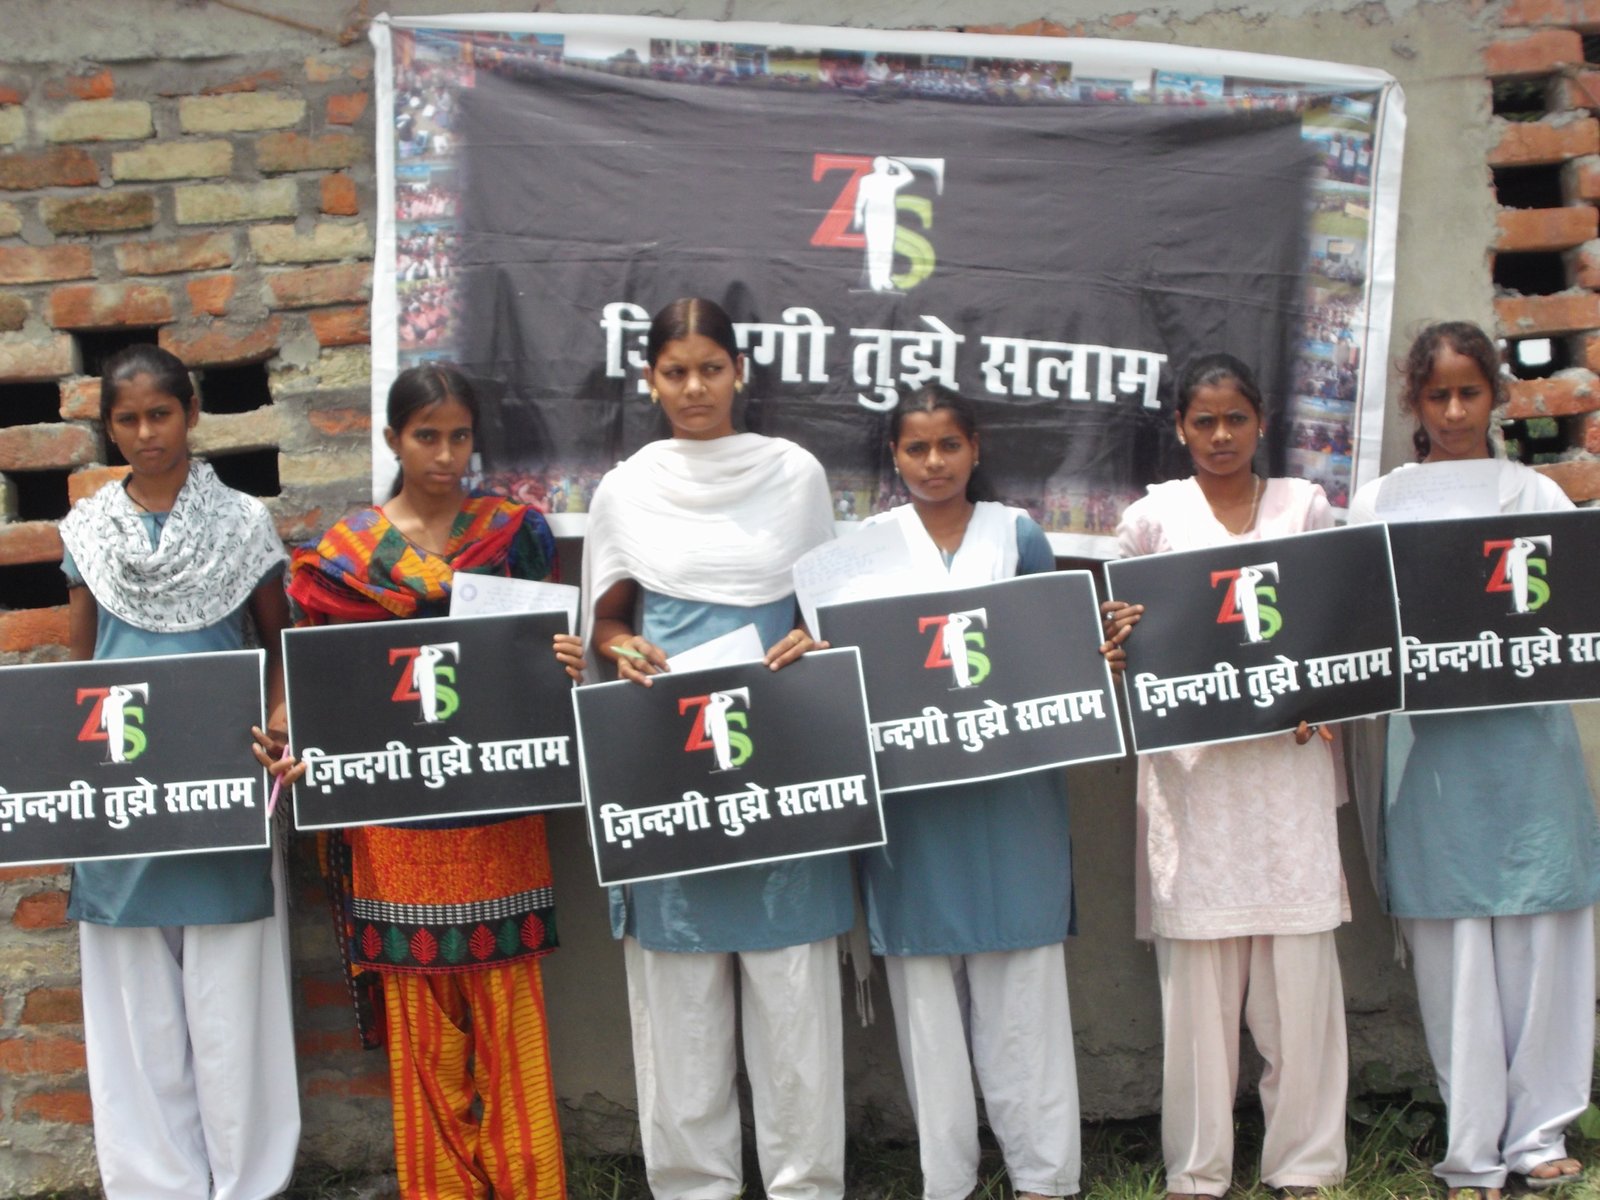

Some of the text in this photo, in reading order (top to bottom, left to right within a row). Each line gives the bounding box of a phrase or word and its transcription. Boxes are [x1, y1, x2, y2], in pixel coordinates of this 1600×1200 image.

[849, 314, 966, 411] तुझे
[980, 335, 1168, 409] सलाम
[1134, 647, 1393, 717] ज़िन्दगी तुझे सलाम
[1508, 627, 1562, 678] तुझे
[952, 699, 1010, 753] तुझे
[1012, 688, 1107, 732] सलाम
[302, 735, 570, 794] ज़िन्दगी तुझे सलाम
[102, 776, 158, 830] तुझे
[163, 777, 256, 813] सलाम
[599, 774, 868, 849] ज़िन्दगी तुझे सलाम
